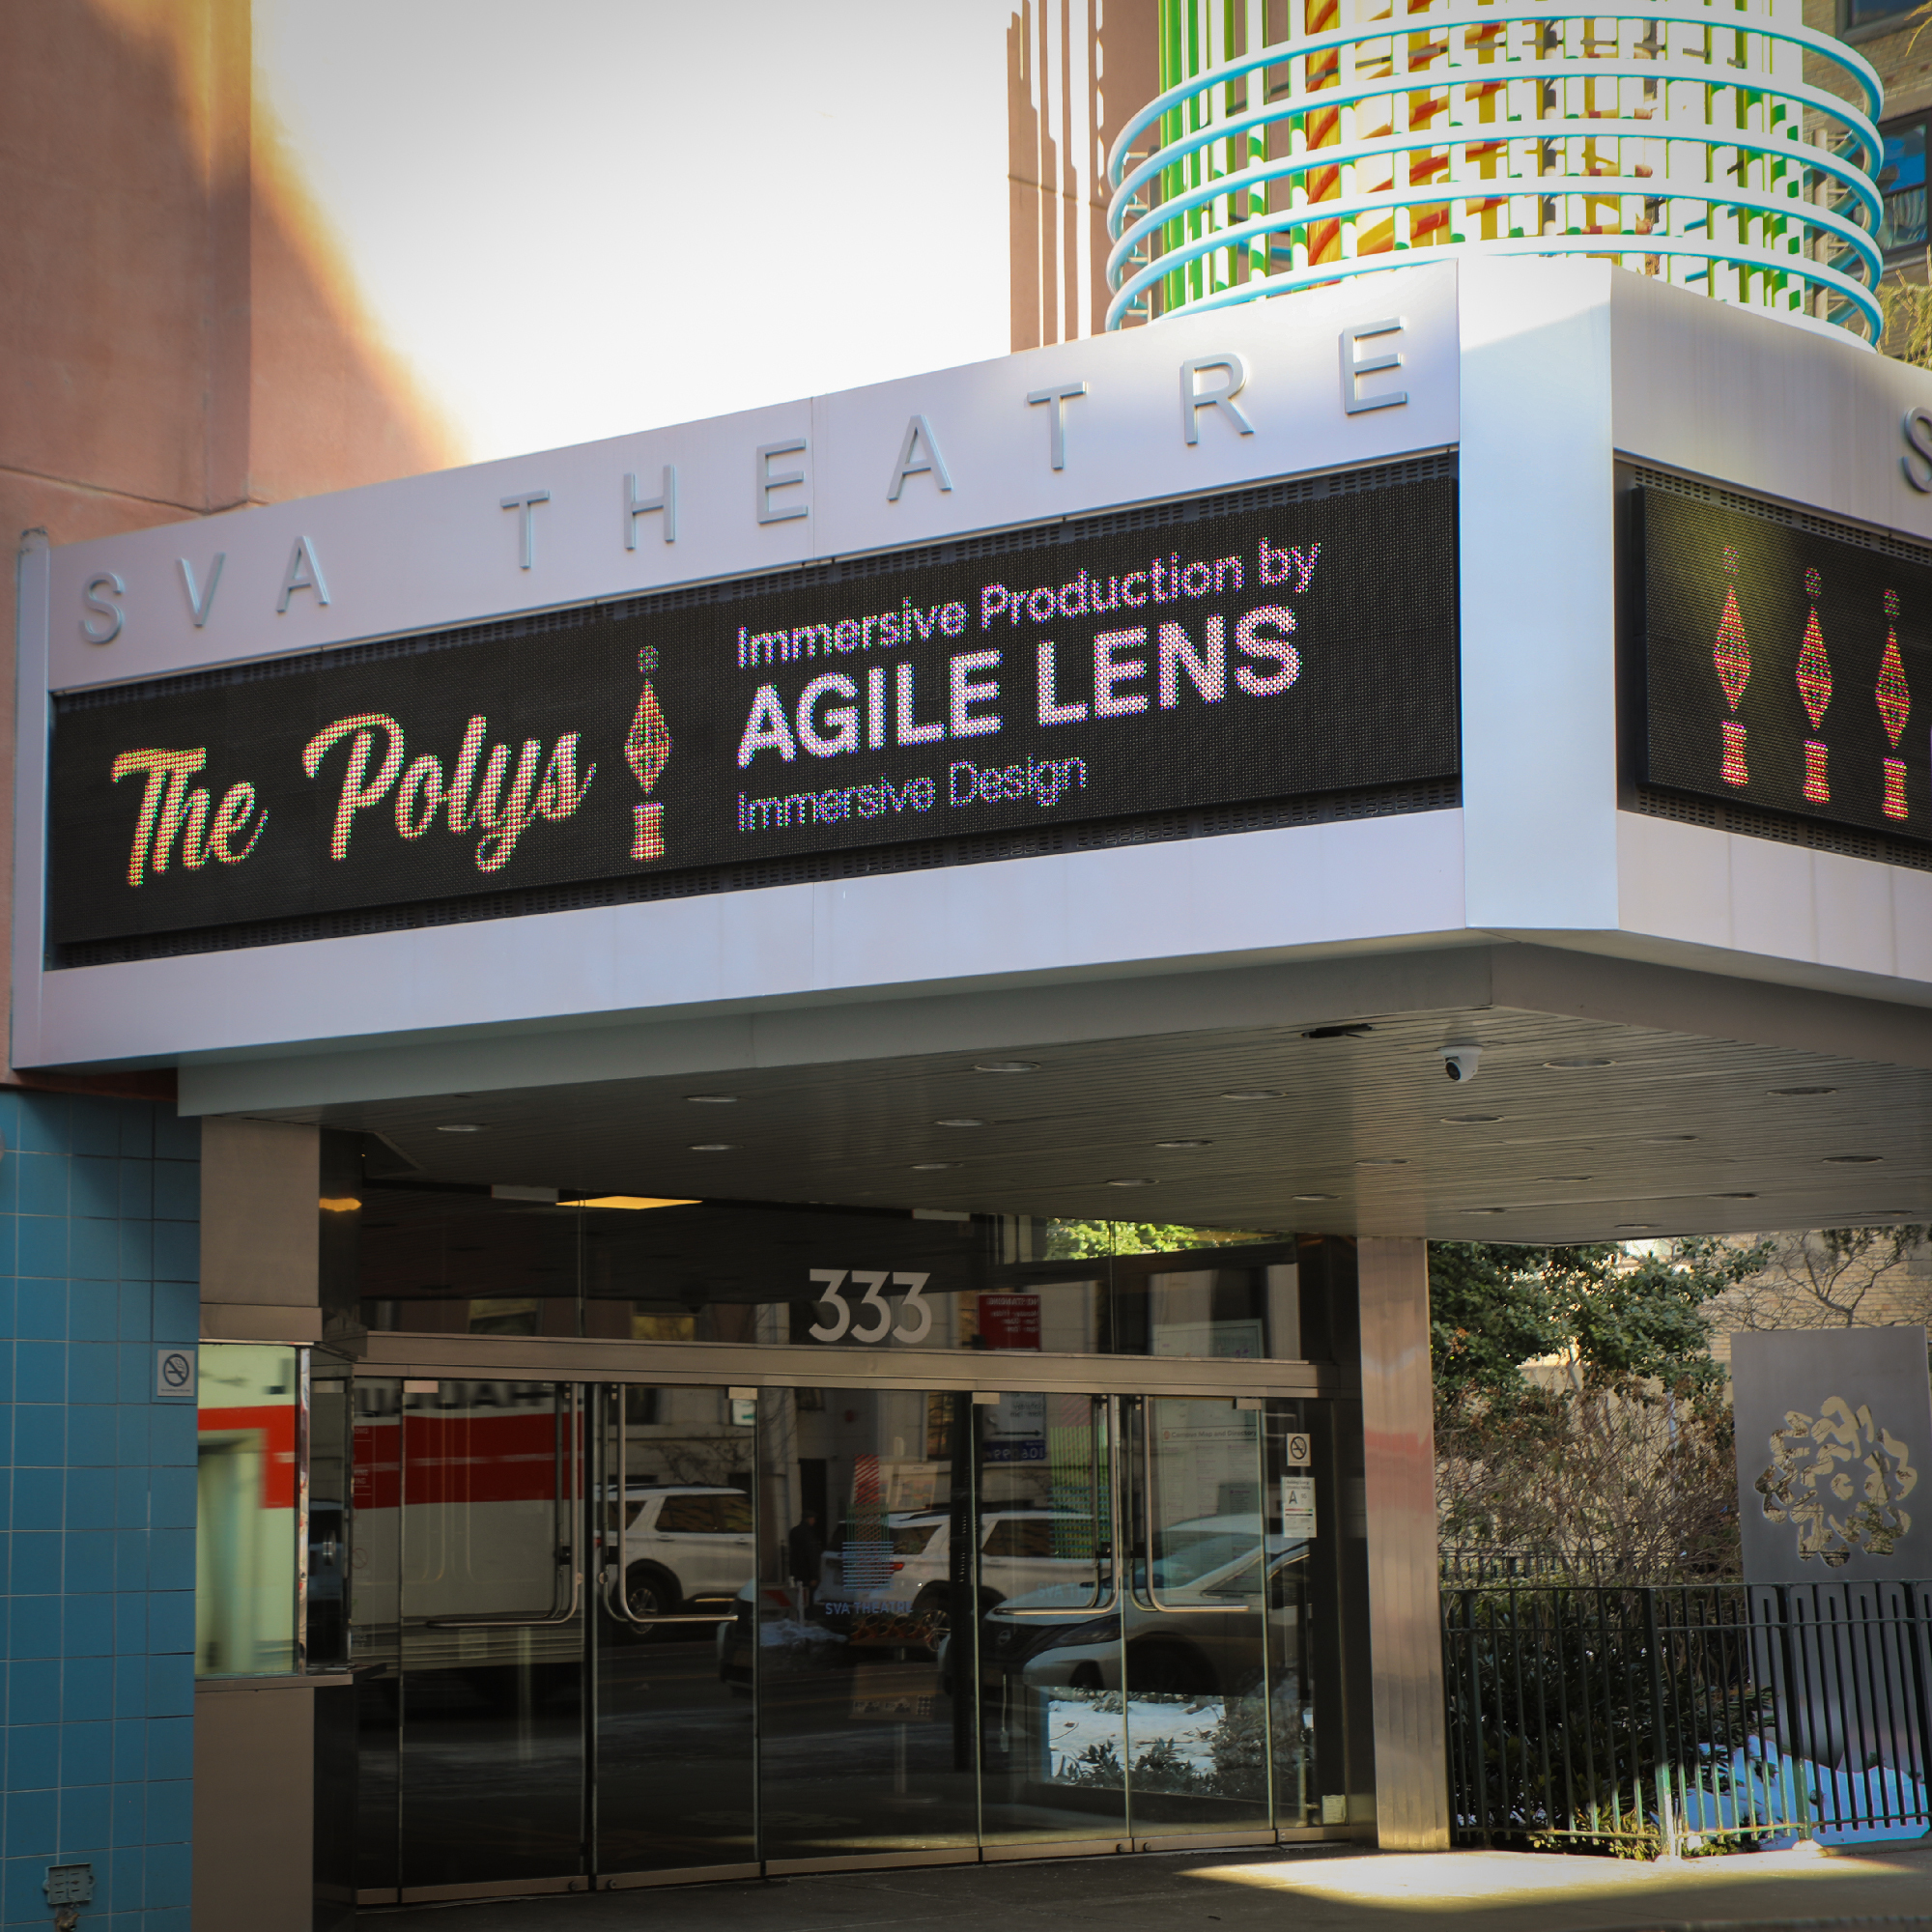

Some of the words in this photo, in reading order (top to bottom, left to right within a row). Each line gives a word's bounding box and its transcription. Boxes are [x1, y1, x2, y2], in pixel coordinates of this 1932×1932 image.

[78, 535, 329, 645] SVA
[499, 317, 1407, 570] THEATRE
[737, 597, 970, 669] Immersive
[980, 552, 1245, 631] Production
[1258, 536, 1321, 594] by
[737, 648, 1003, 770] AGILE
[1036, 604, 1303, 726] LENS
[111, 747, 269, 887] The
[302, 712, 596, 872] Polys
[737, 774, 937, 831] Immersive
[949, 755, 1088, 807] Design
[809, 1268, 932, 1344] 333
[1289, 1490, 1298, 1504] A
[825, 1602, 851, 1615] SVA
[853, 1600, 914, 1614] THEATRE
